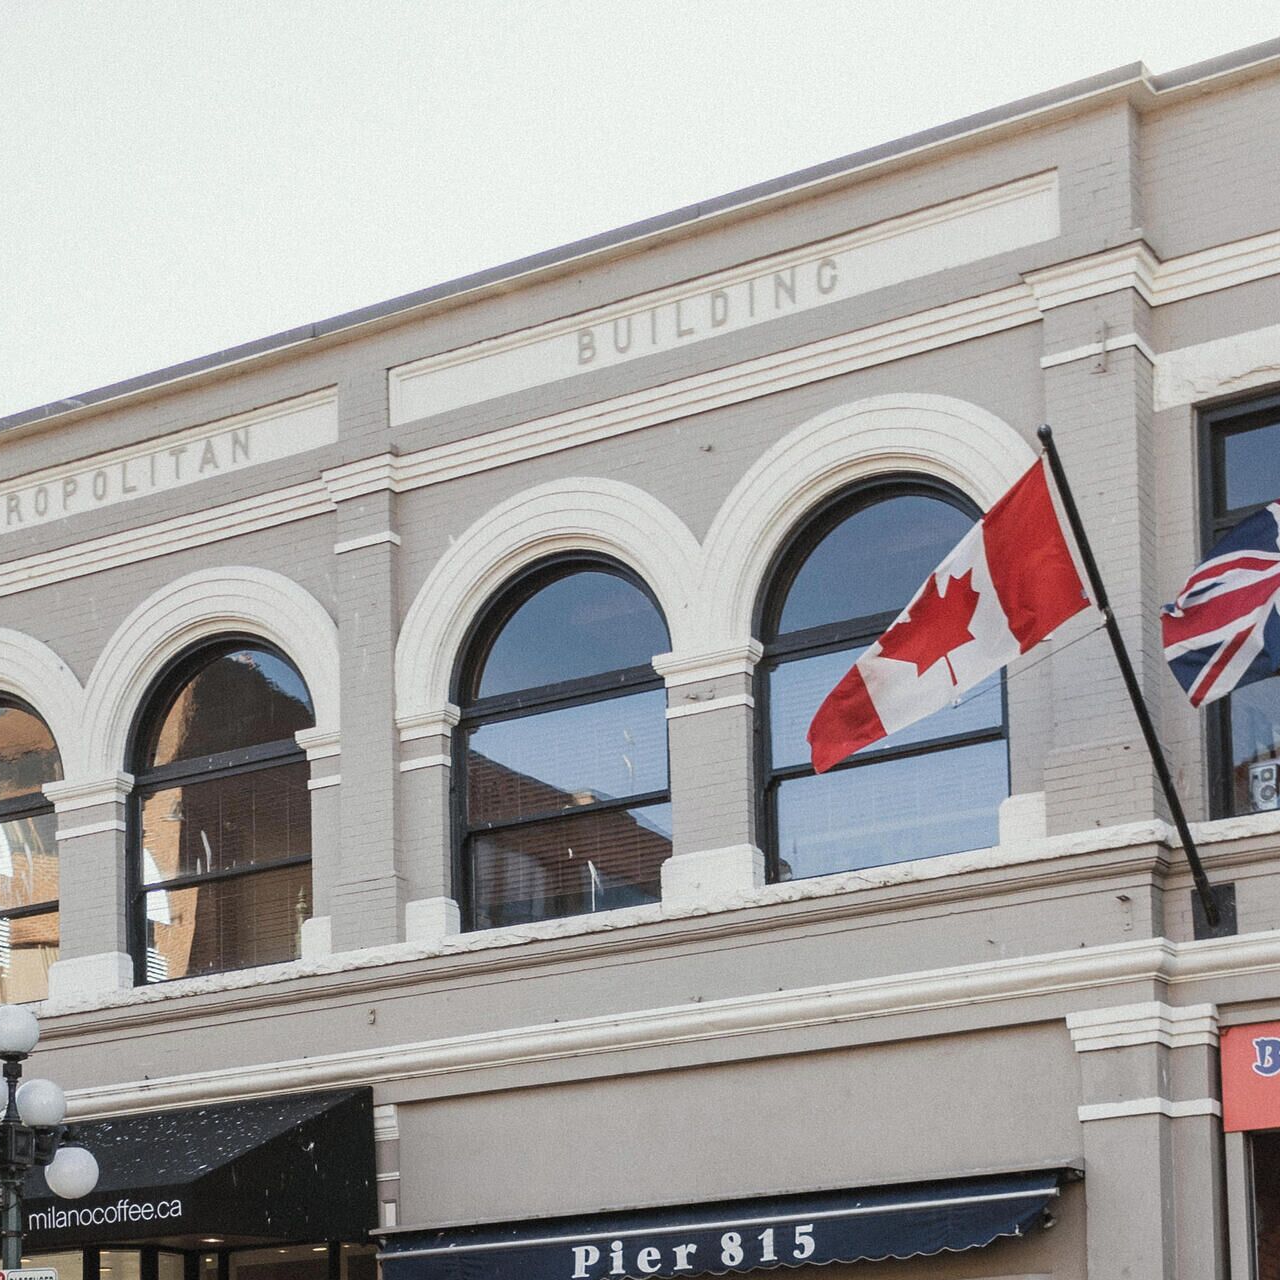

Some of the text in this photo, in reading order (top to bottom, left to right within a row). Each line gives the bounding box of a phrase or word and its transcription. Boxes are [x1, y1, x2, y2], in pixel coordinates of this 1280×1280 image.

[578, 259, 838, 364] BUILDING
[28, 1199, 182, 1231] milanocoffee.ca
[571, 1223, 816, 1279] Pier 815
